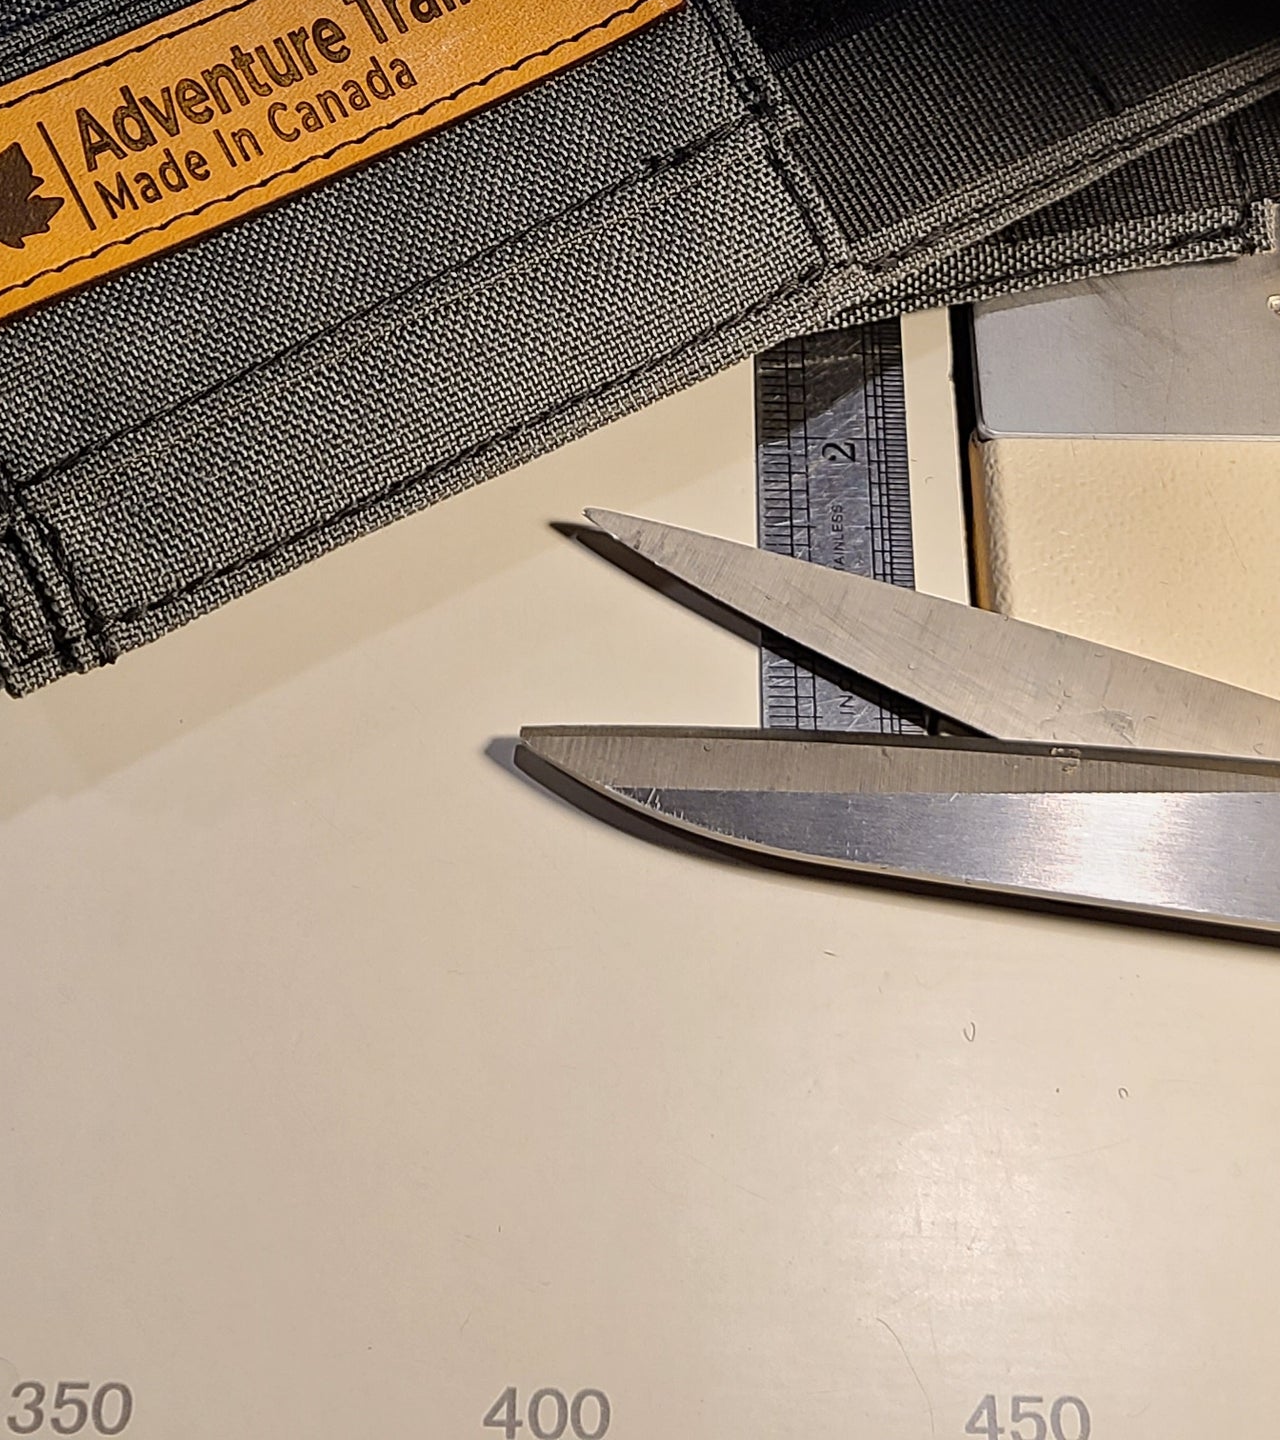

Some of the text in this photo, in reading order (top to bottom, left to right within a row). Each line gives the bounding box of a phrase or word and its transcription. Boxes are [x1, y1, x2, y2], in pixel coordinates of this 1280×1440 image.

[75, 17, 351, 172] Adventure
[93, 56, 418, 220] Made In Canada
[822, 442, 856, 463] 2
[831, 504, 845, 571] TAINLESS
[6, 1381, 133, 1435] 350
[482, 1386, 611, 1440] 400
[965, 1394, 1091, 1440] 450
